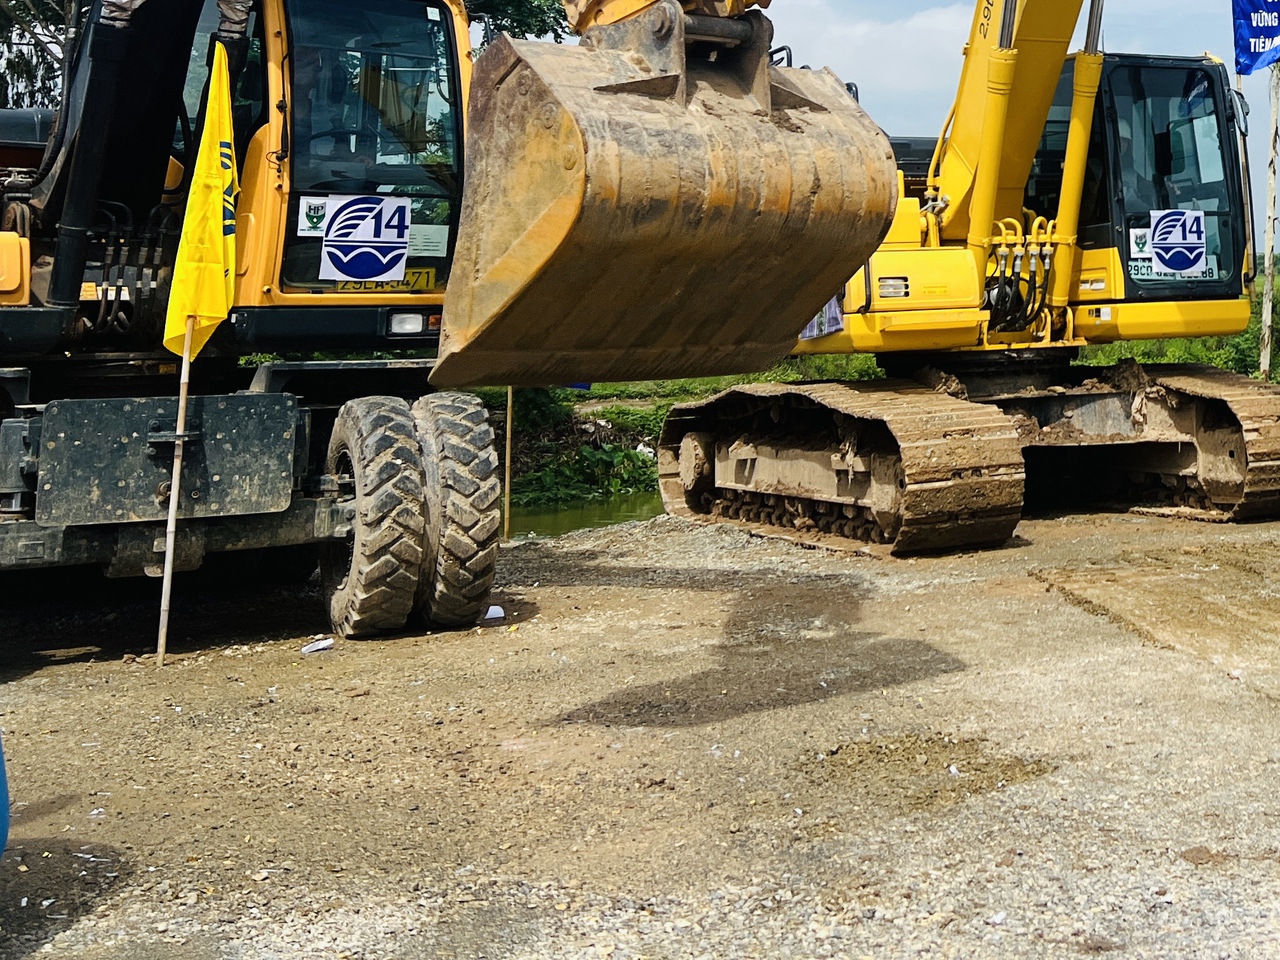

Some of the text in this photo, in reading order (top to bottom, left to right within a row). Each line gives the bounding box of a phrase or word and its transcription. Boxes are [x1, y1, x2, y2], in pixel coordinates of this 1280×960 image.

[1250, 10, 1278, 27] VỮNG
[308, 205, 324, 215] HP
[370, 205, 409, 239] 14
[1179, 216, 1204, 241] 14
